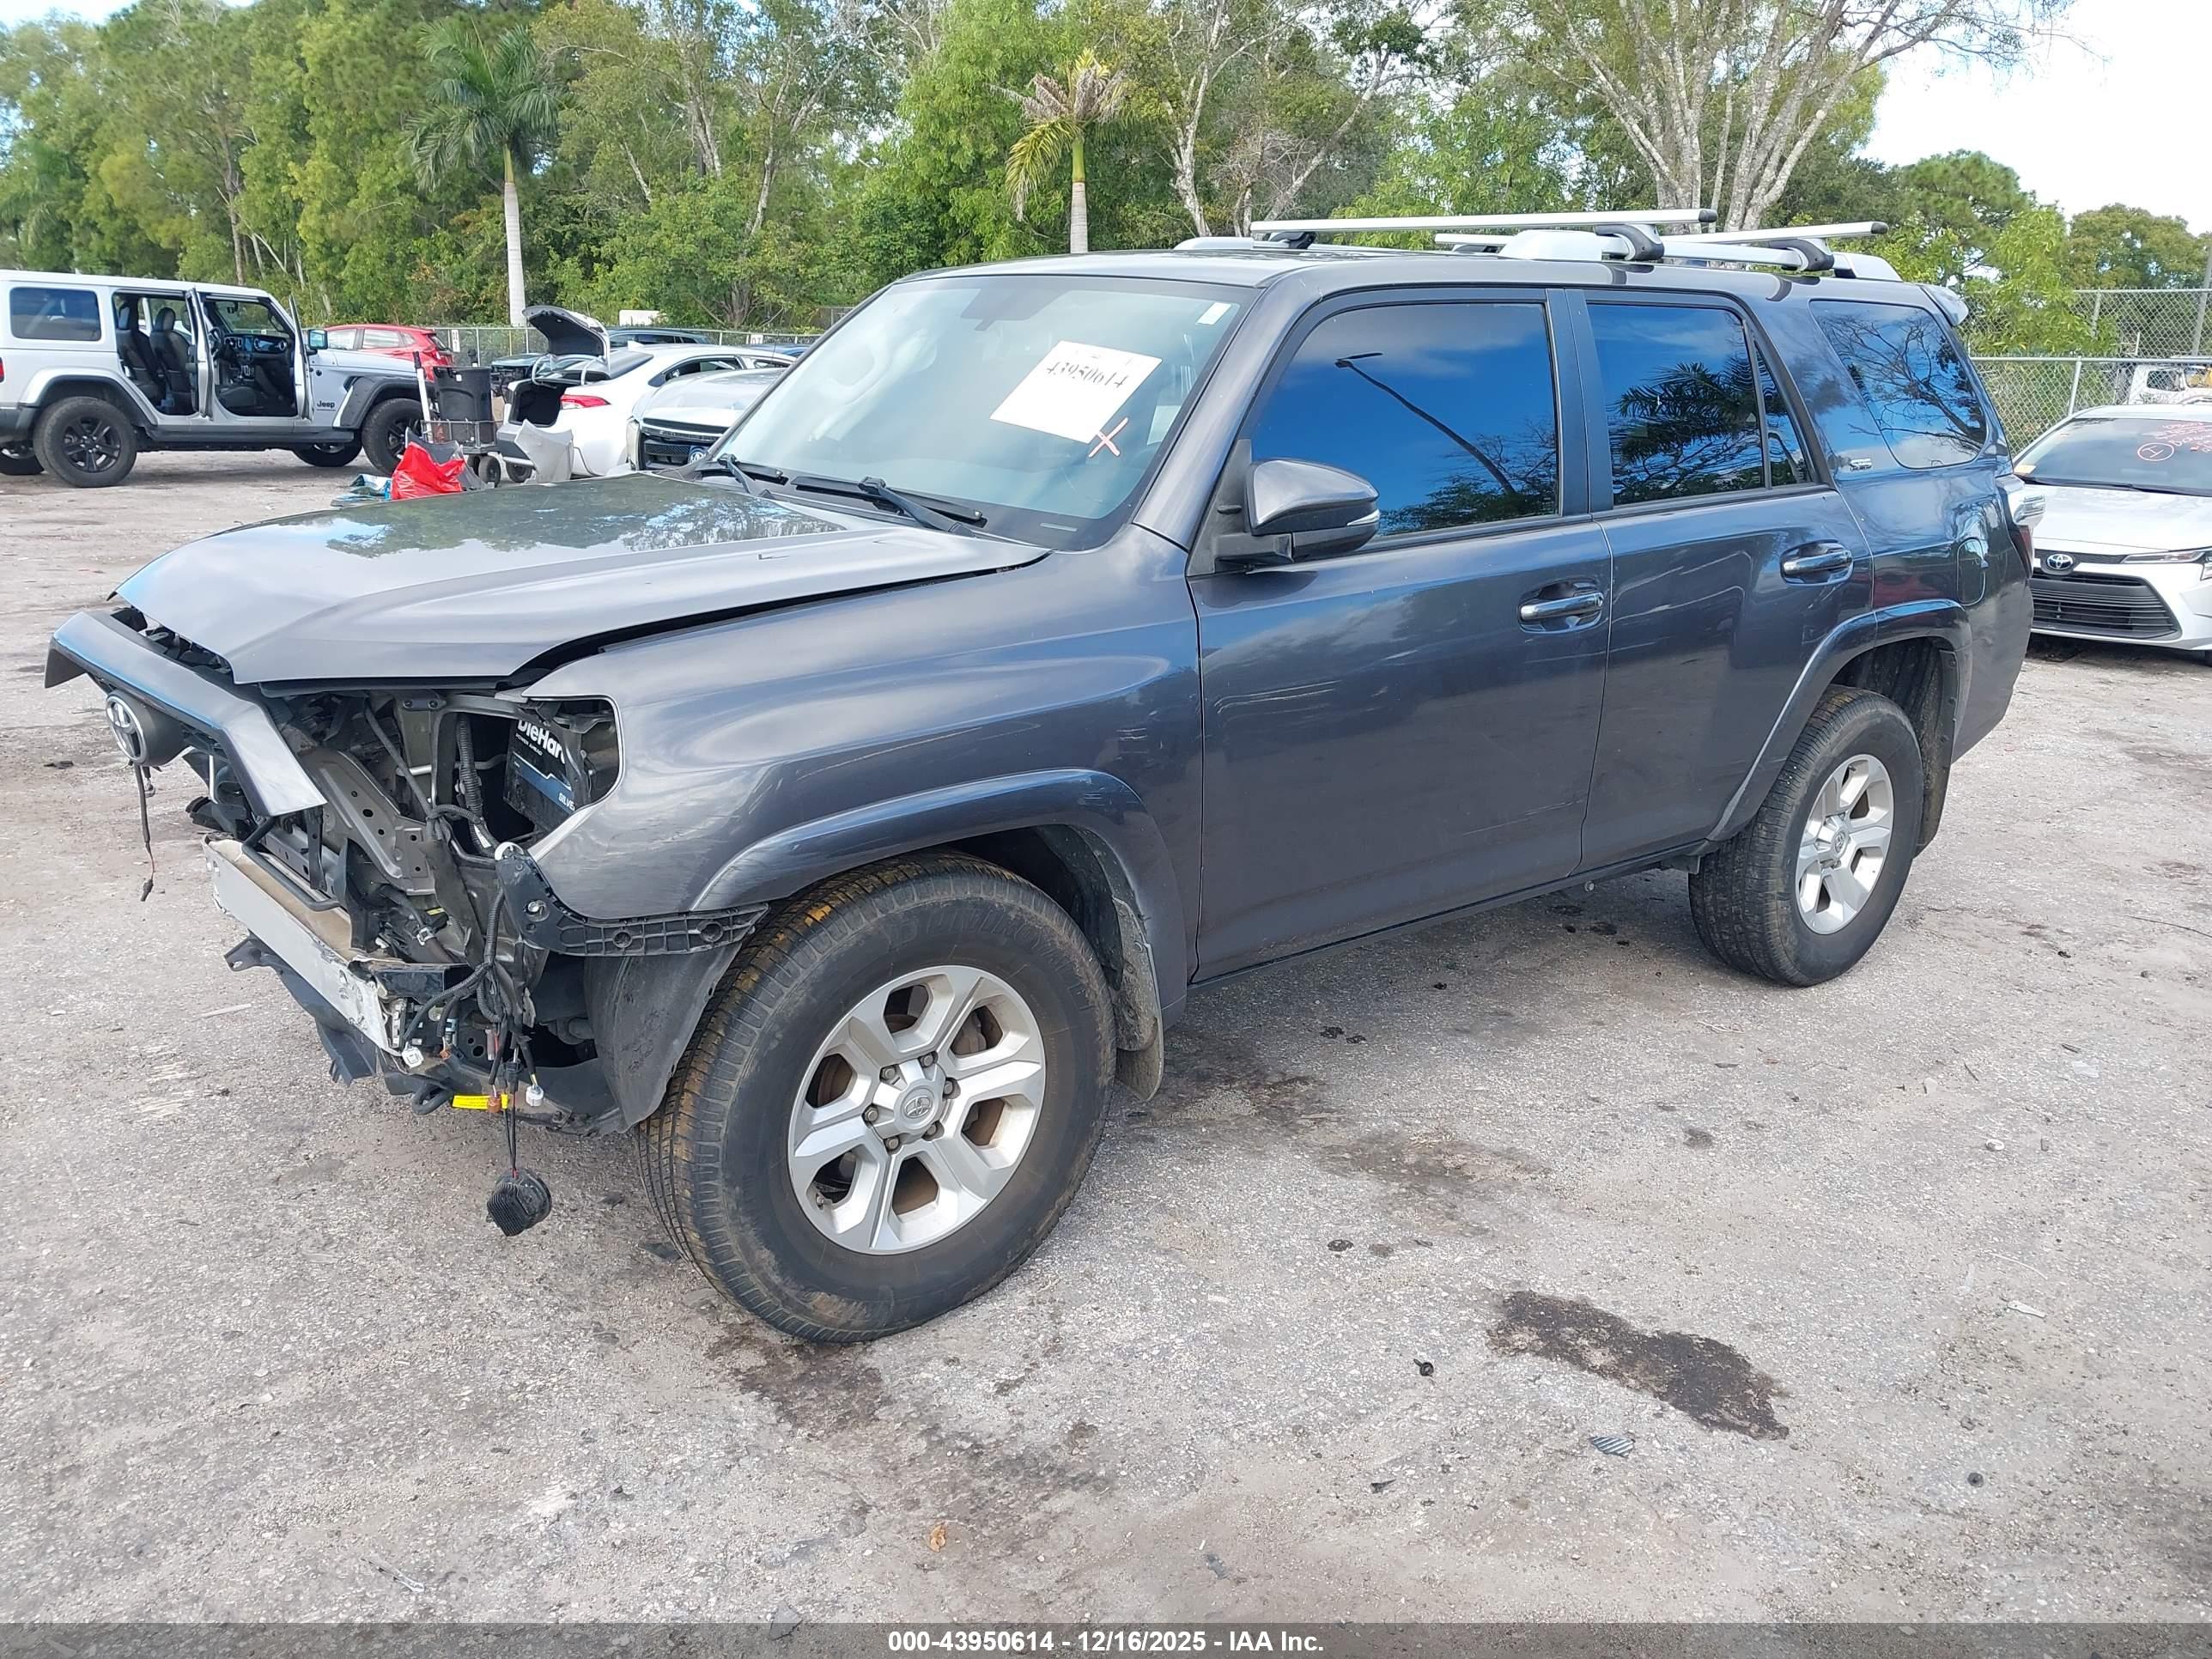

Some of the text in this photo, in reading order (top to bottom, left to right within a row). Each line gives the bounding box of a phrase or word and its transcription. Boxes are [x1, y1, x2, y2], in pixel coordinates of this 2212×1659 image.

[316, 400, 336, 410] Jeep
[517, 720, 566, 765] DieHar
[558, 792, 576, 812] SILVE
